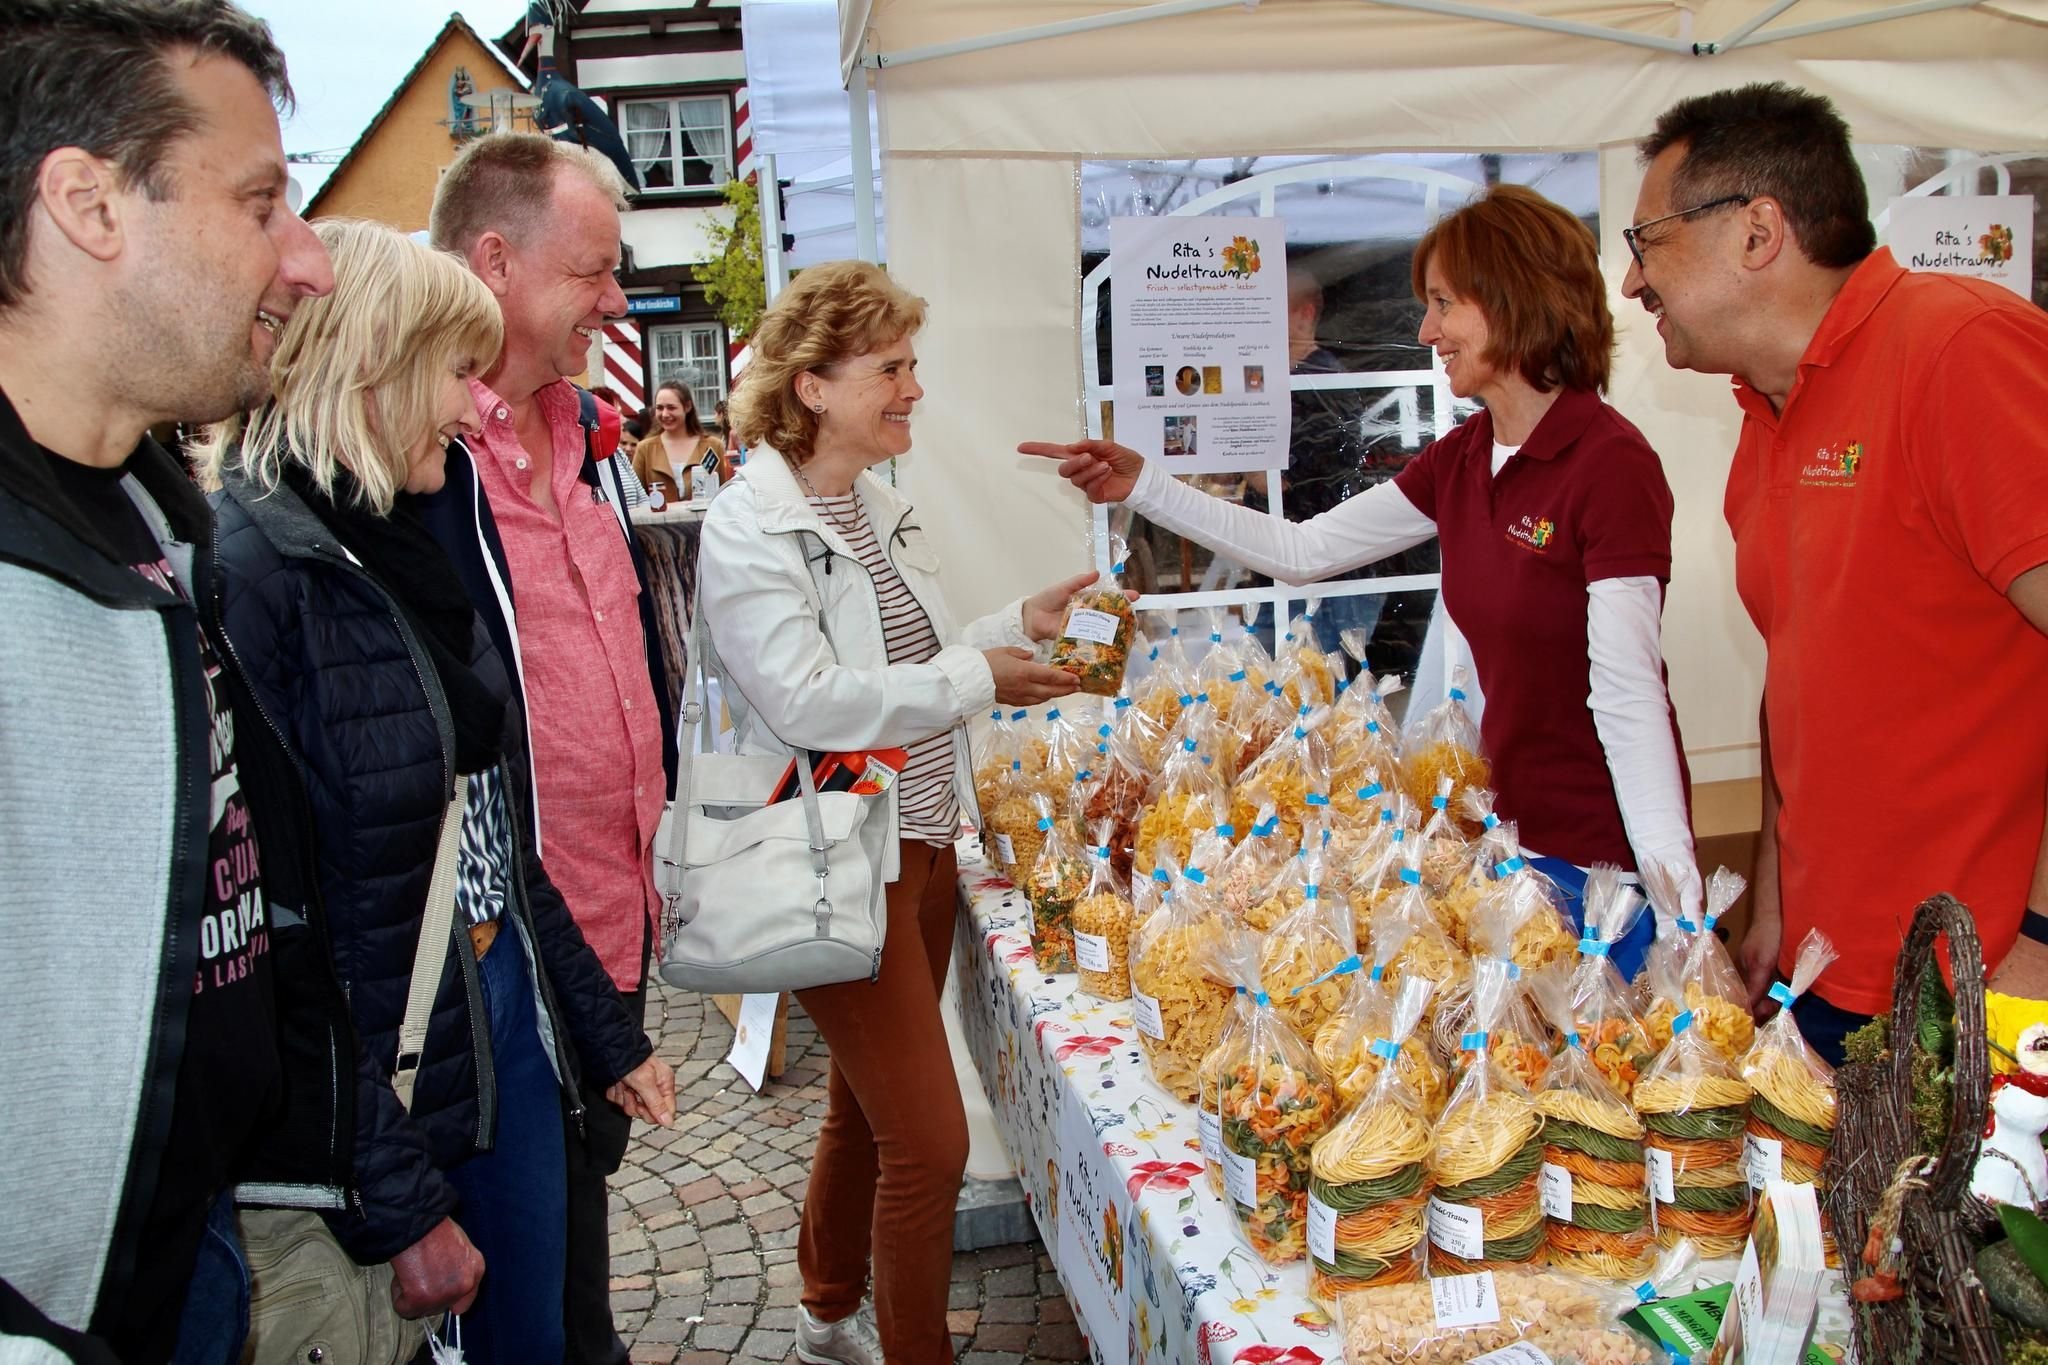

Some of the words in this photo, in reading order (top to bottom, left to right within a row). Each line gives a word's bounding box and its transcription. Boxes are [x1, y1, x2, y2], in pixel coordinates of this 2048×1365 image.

[1912, 252, 1995, 268] Nudeltraum
[1146, 264, 1241, 280] Nudeltraum
[1065, 1169, 1112, 1285] Nudeltraum
[1694, 1299, 1723, 1325] MEN
